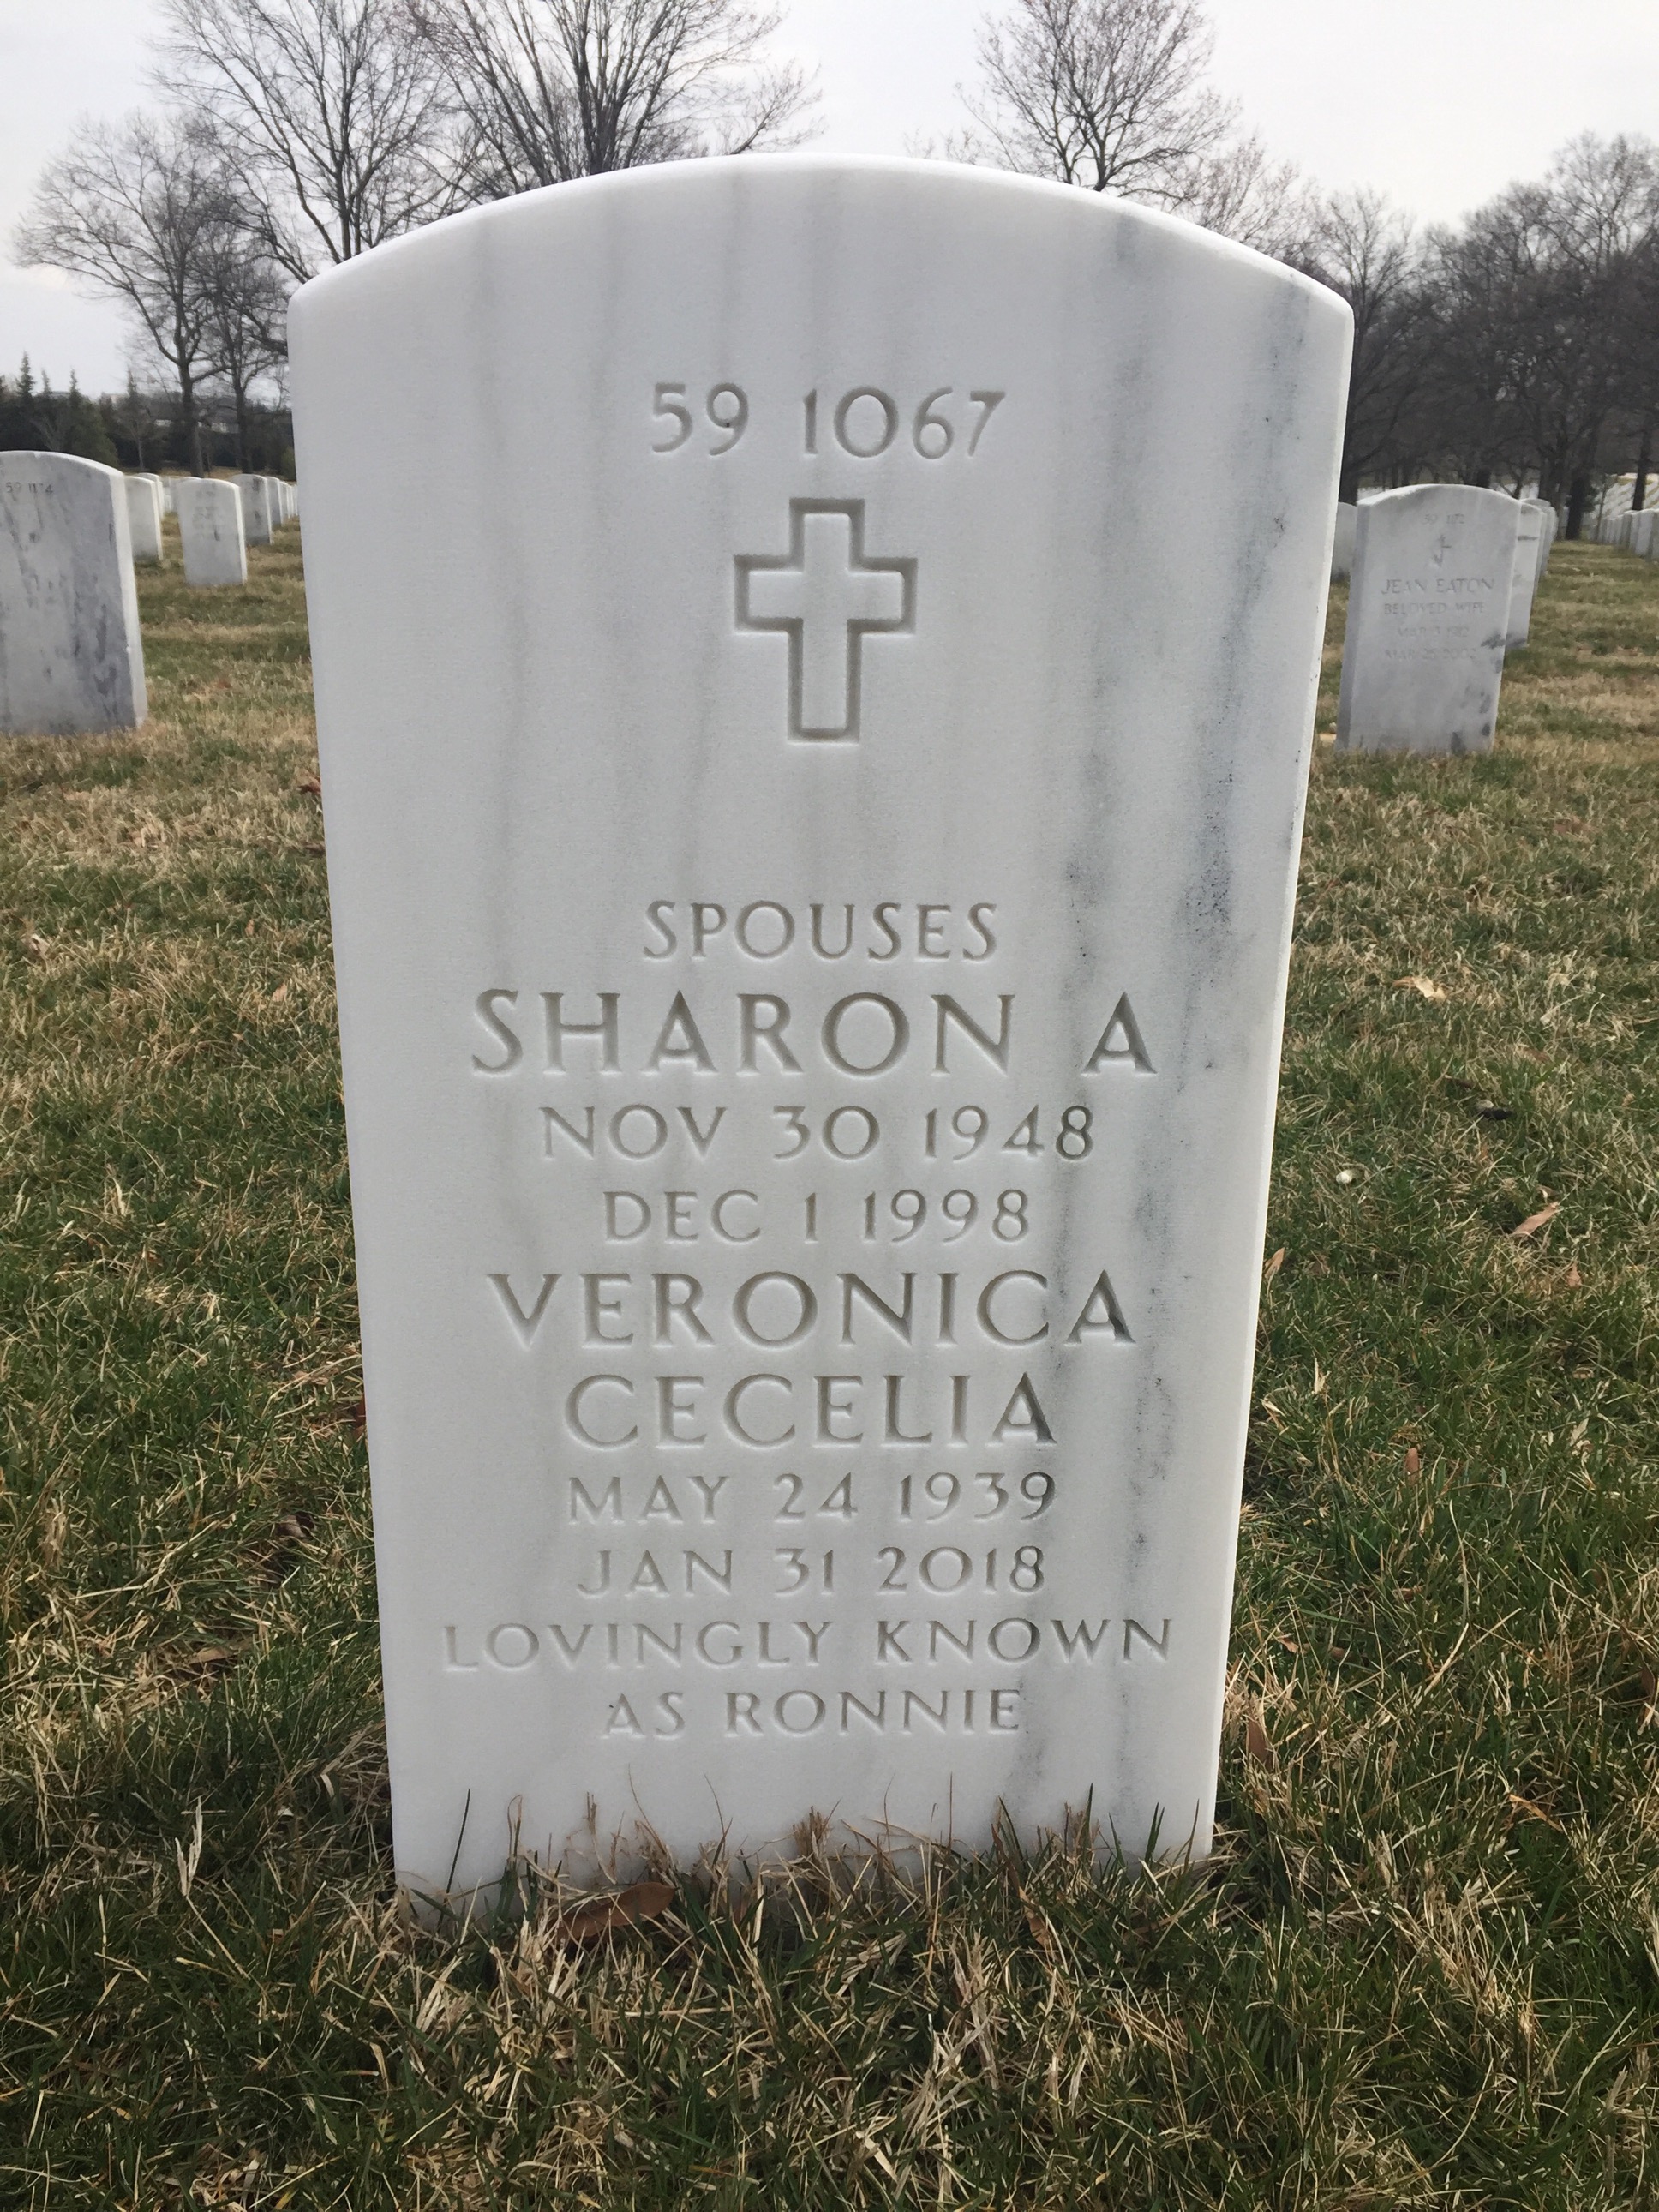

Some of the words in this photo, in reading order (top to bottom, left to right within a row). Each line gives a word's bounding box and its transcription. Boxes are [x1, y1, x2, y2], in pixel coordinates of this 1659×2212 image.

[652, 382, 749, 456] 59
[804, 386, 1006, 460] 1067
[1381, 579, 1428, 595] JEAN
[1436, 578, 1494, 593] EATON
[1384, 602, 1447, 614] BELOVED
[644, 900, 997, 962] SPOUSES
[472, 988, 1016, 1078] SHARON
[1081, 991, 1158, 1076] A
[539, 1106, 728, 1160] NOV
[772, 1106, 880, 1161] 30
[925, 1105, 1095, 1161] 1948
[602, 1190, 763, 1244] DEC
[804, 1190, 818, 1244] 1
[864, 1189, 1031, 1244] 1998
[488, 1269, 1135, 1351] VERONICA
[565, 1371, 1058, 1449] CECELIA
[568, 1474, 730, 1526] MAY
[774, 1472, 859, 1522] 24
[900, 1471, 1057, 1522] 1939
[578, 1548, 734, 1598] JAN
[774, 1546, 835, 1597] 31
[878, 1544, 1046, 1597] 2018
[441, 1618, 834, 1674] LOVINGLY
[876, 1616, 1173, 1670] KNOWN
[601, 1690, 685, 1741] AS
[726, 1689, 1021, 1737] RONNIE
